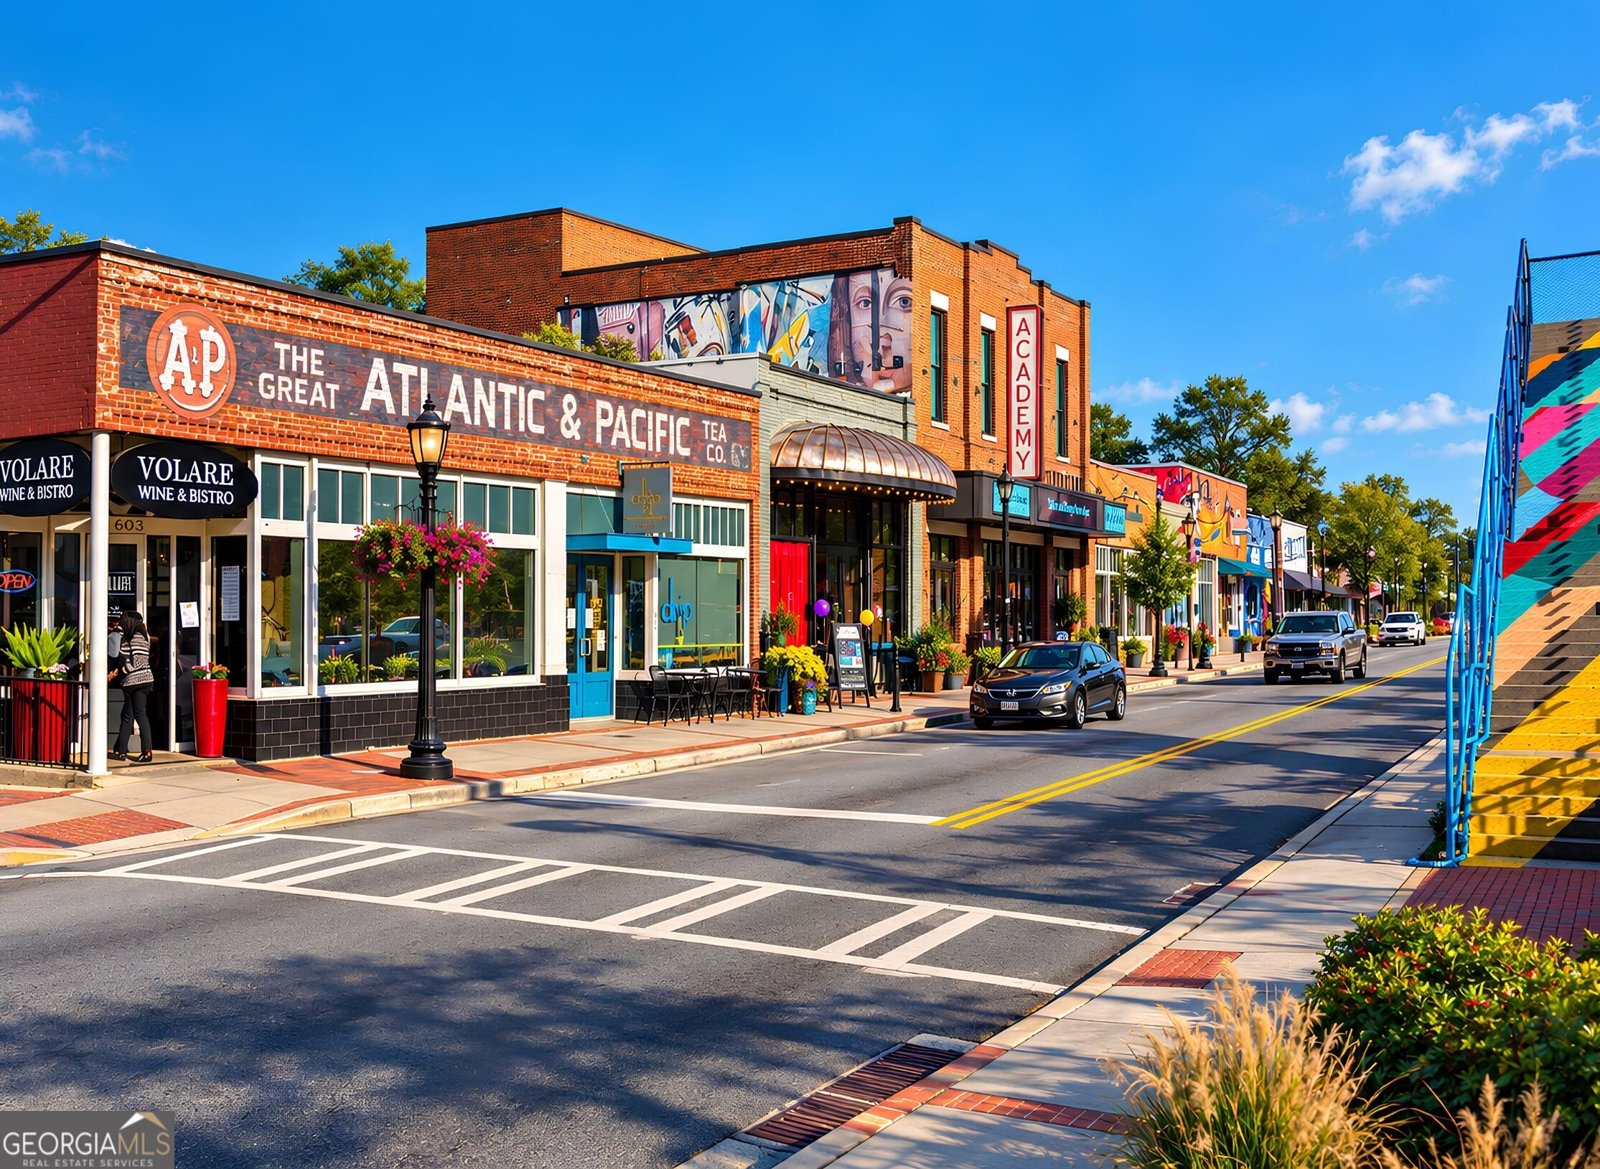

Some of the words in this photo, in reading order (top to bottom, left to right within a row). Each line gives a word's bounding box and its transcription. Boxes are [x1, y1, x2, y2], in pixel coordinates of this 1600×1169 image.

[273, 342, 325, 377] THE
[258, 373, 340, 410] GREAT
[1015, 317, 1031, 470] ACADEMY
[360, 357, 546, 435] ATLANTIC
[560, 393, 582, 441] &
[595, 399, 691, 457] PACIFIC
[702, 420, 727, 442] TEA
[706, 443, 727, 463] CO.
[0, 455, 74, 482] VOLARE
[136, 455, 235, 486] VOLARE
[0, 487, 26, 501] WINE
[27, 487, 35, 500] &
[37, 484, 74, 499] BISTRO
[137, 485, 175, 501] WINE
[177, 488, 187, 502] &
[189, 489, 234, 505] BISTRO
[114, 519, 144, 531] 603
[0, 574, 32, 589] OPEN
